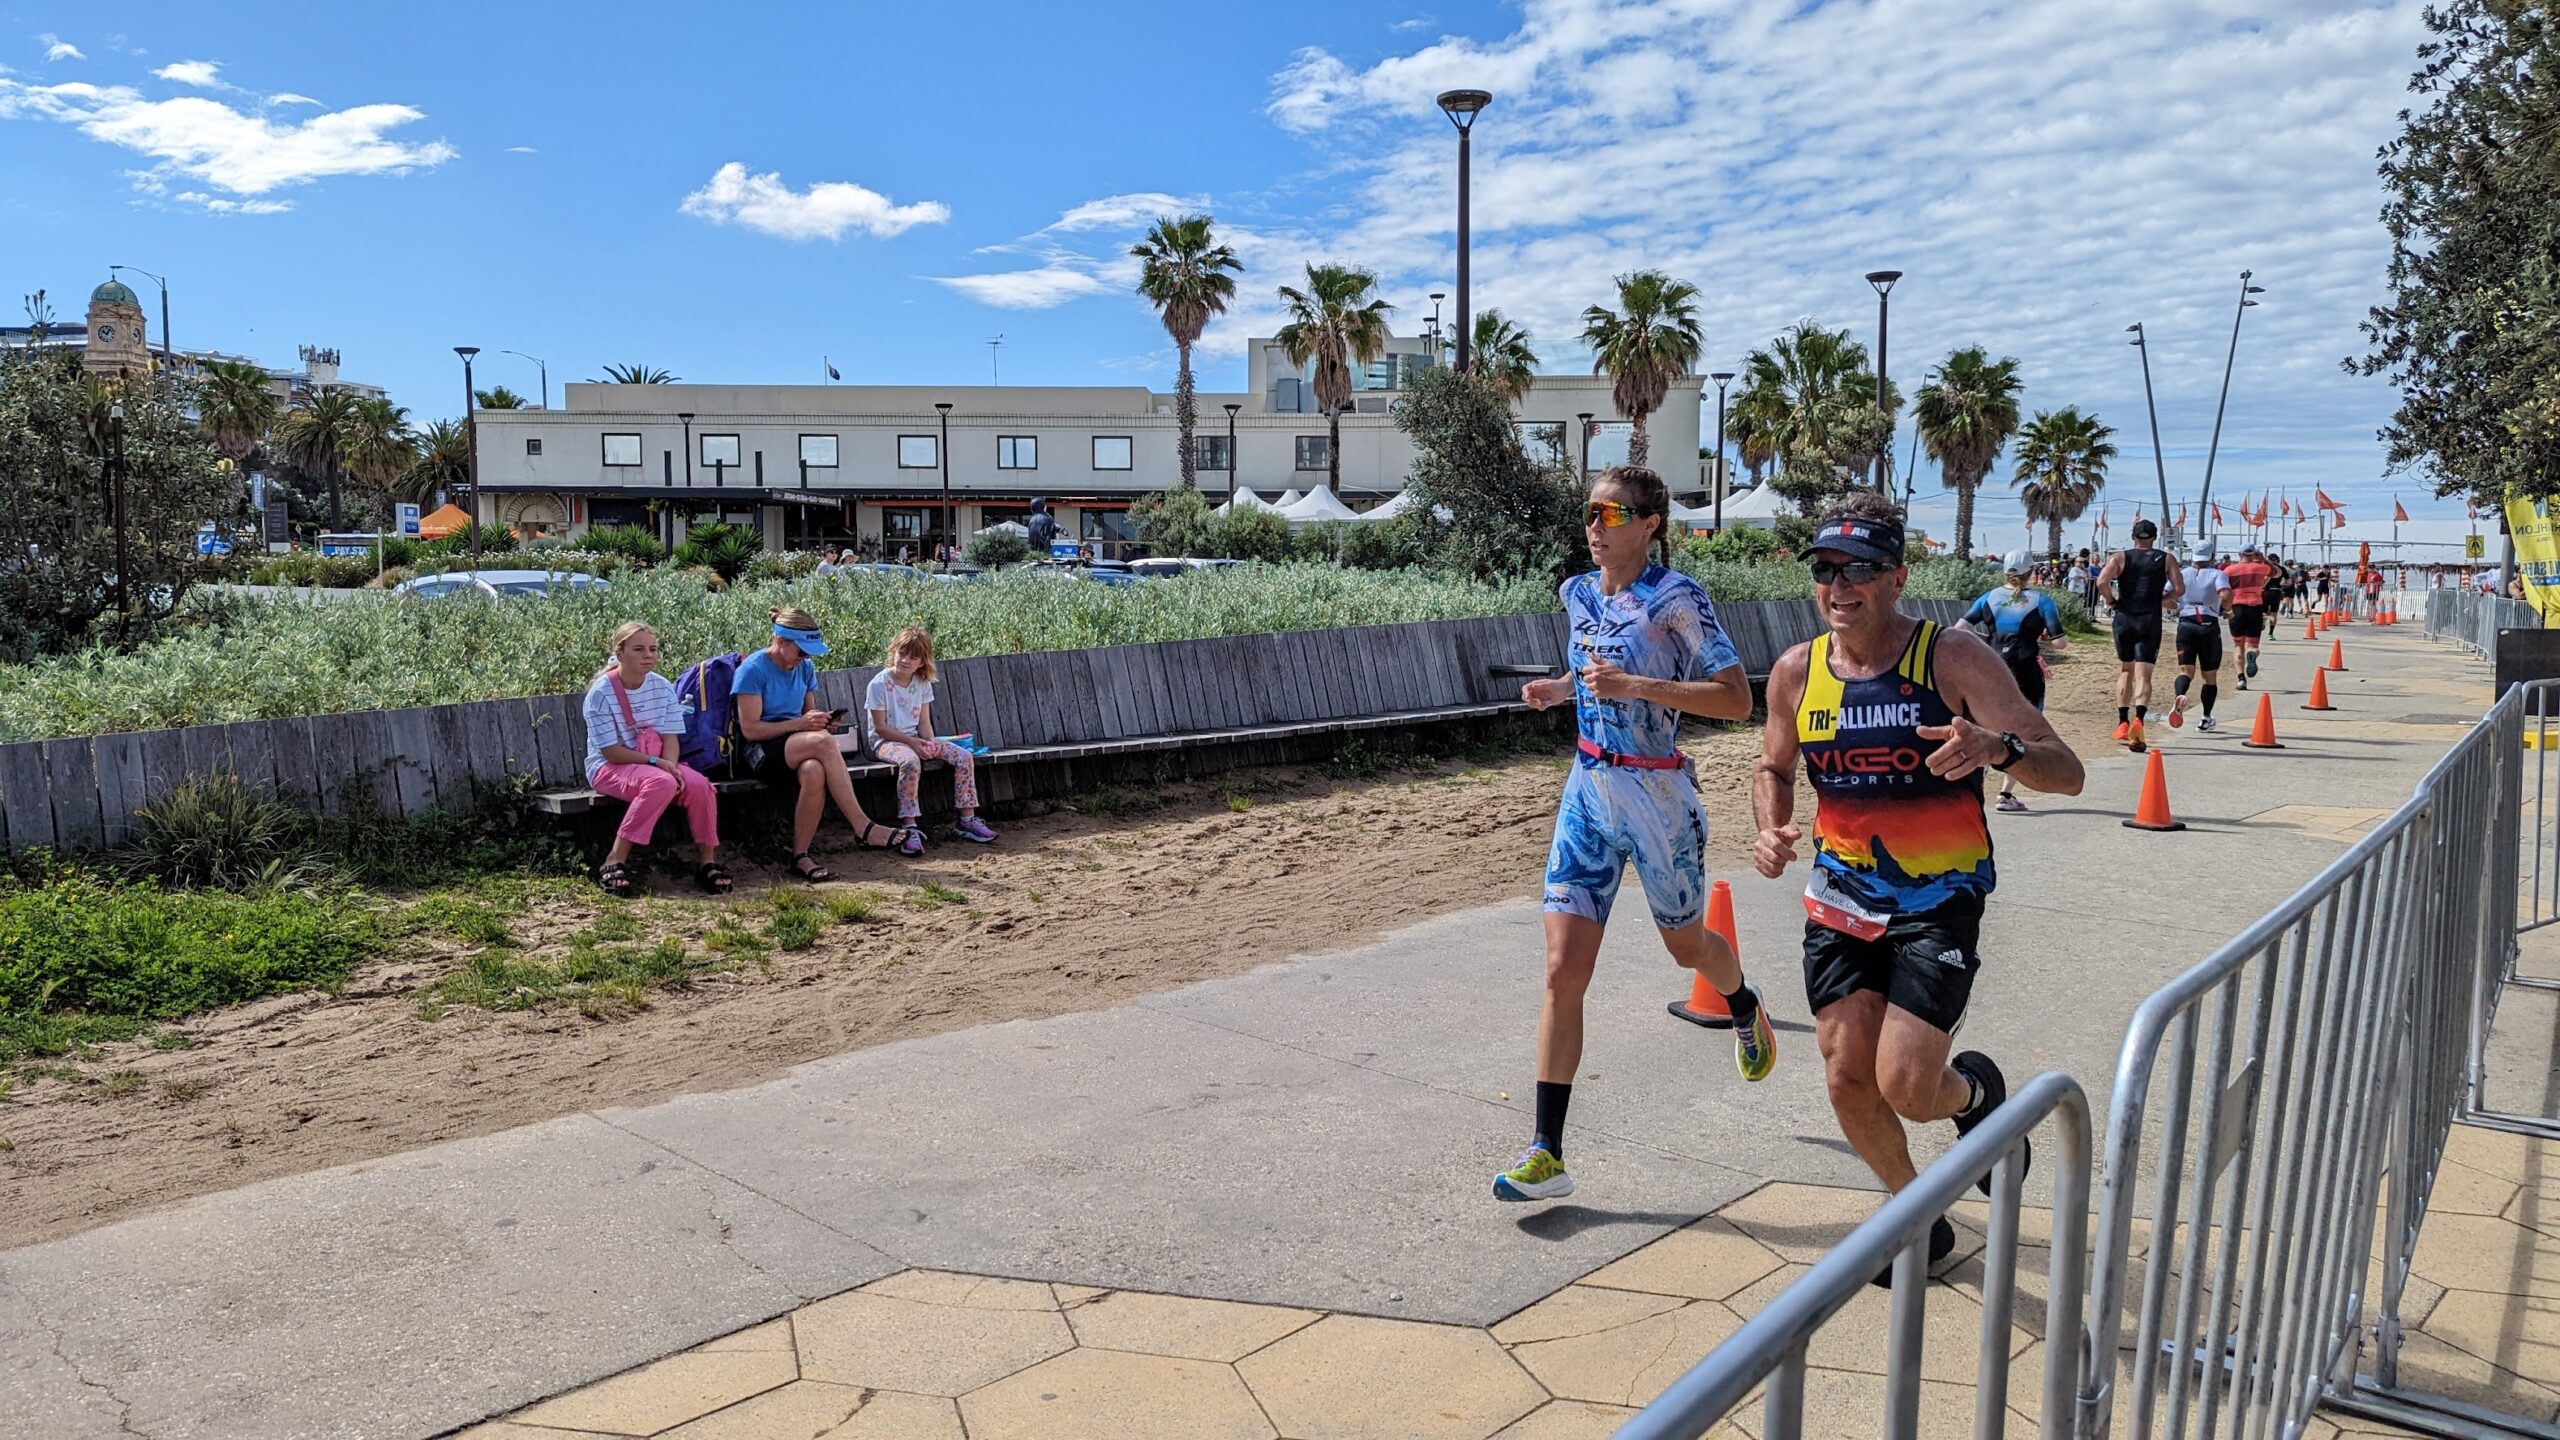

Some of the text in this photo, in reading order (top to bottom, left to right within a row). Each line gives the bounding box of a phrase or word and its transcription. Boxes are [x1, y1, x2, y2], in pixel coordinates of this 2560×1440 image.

[1820, 521, 1871, 539] IRONMAN
[335, 546, 349, 555] PAY
[1573, 642, 1627, 654] TREK
[1808, 703, 1921, 732] TRI-ALLIANCE
[1810, 747, 1920, 774] VIGEO
[1825, 893, 1845, 907] HAVE
[1938, 954, 1966, 969] adidas
